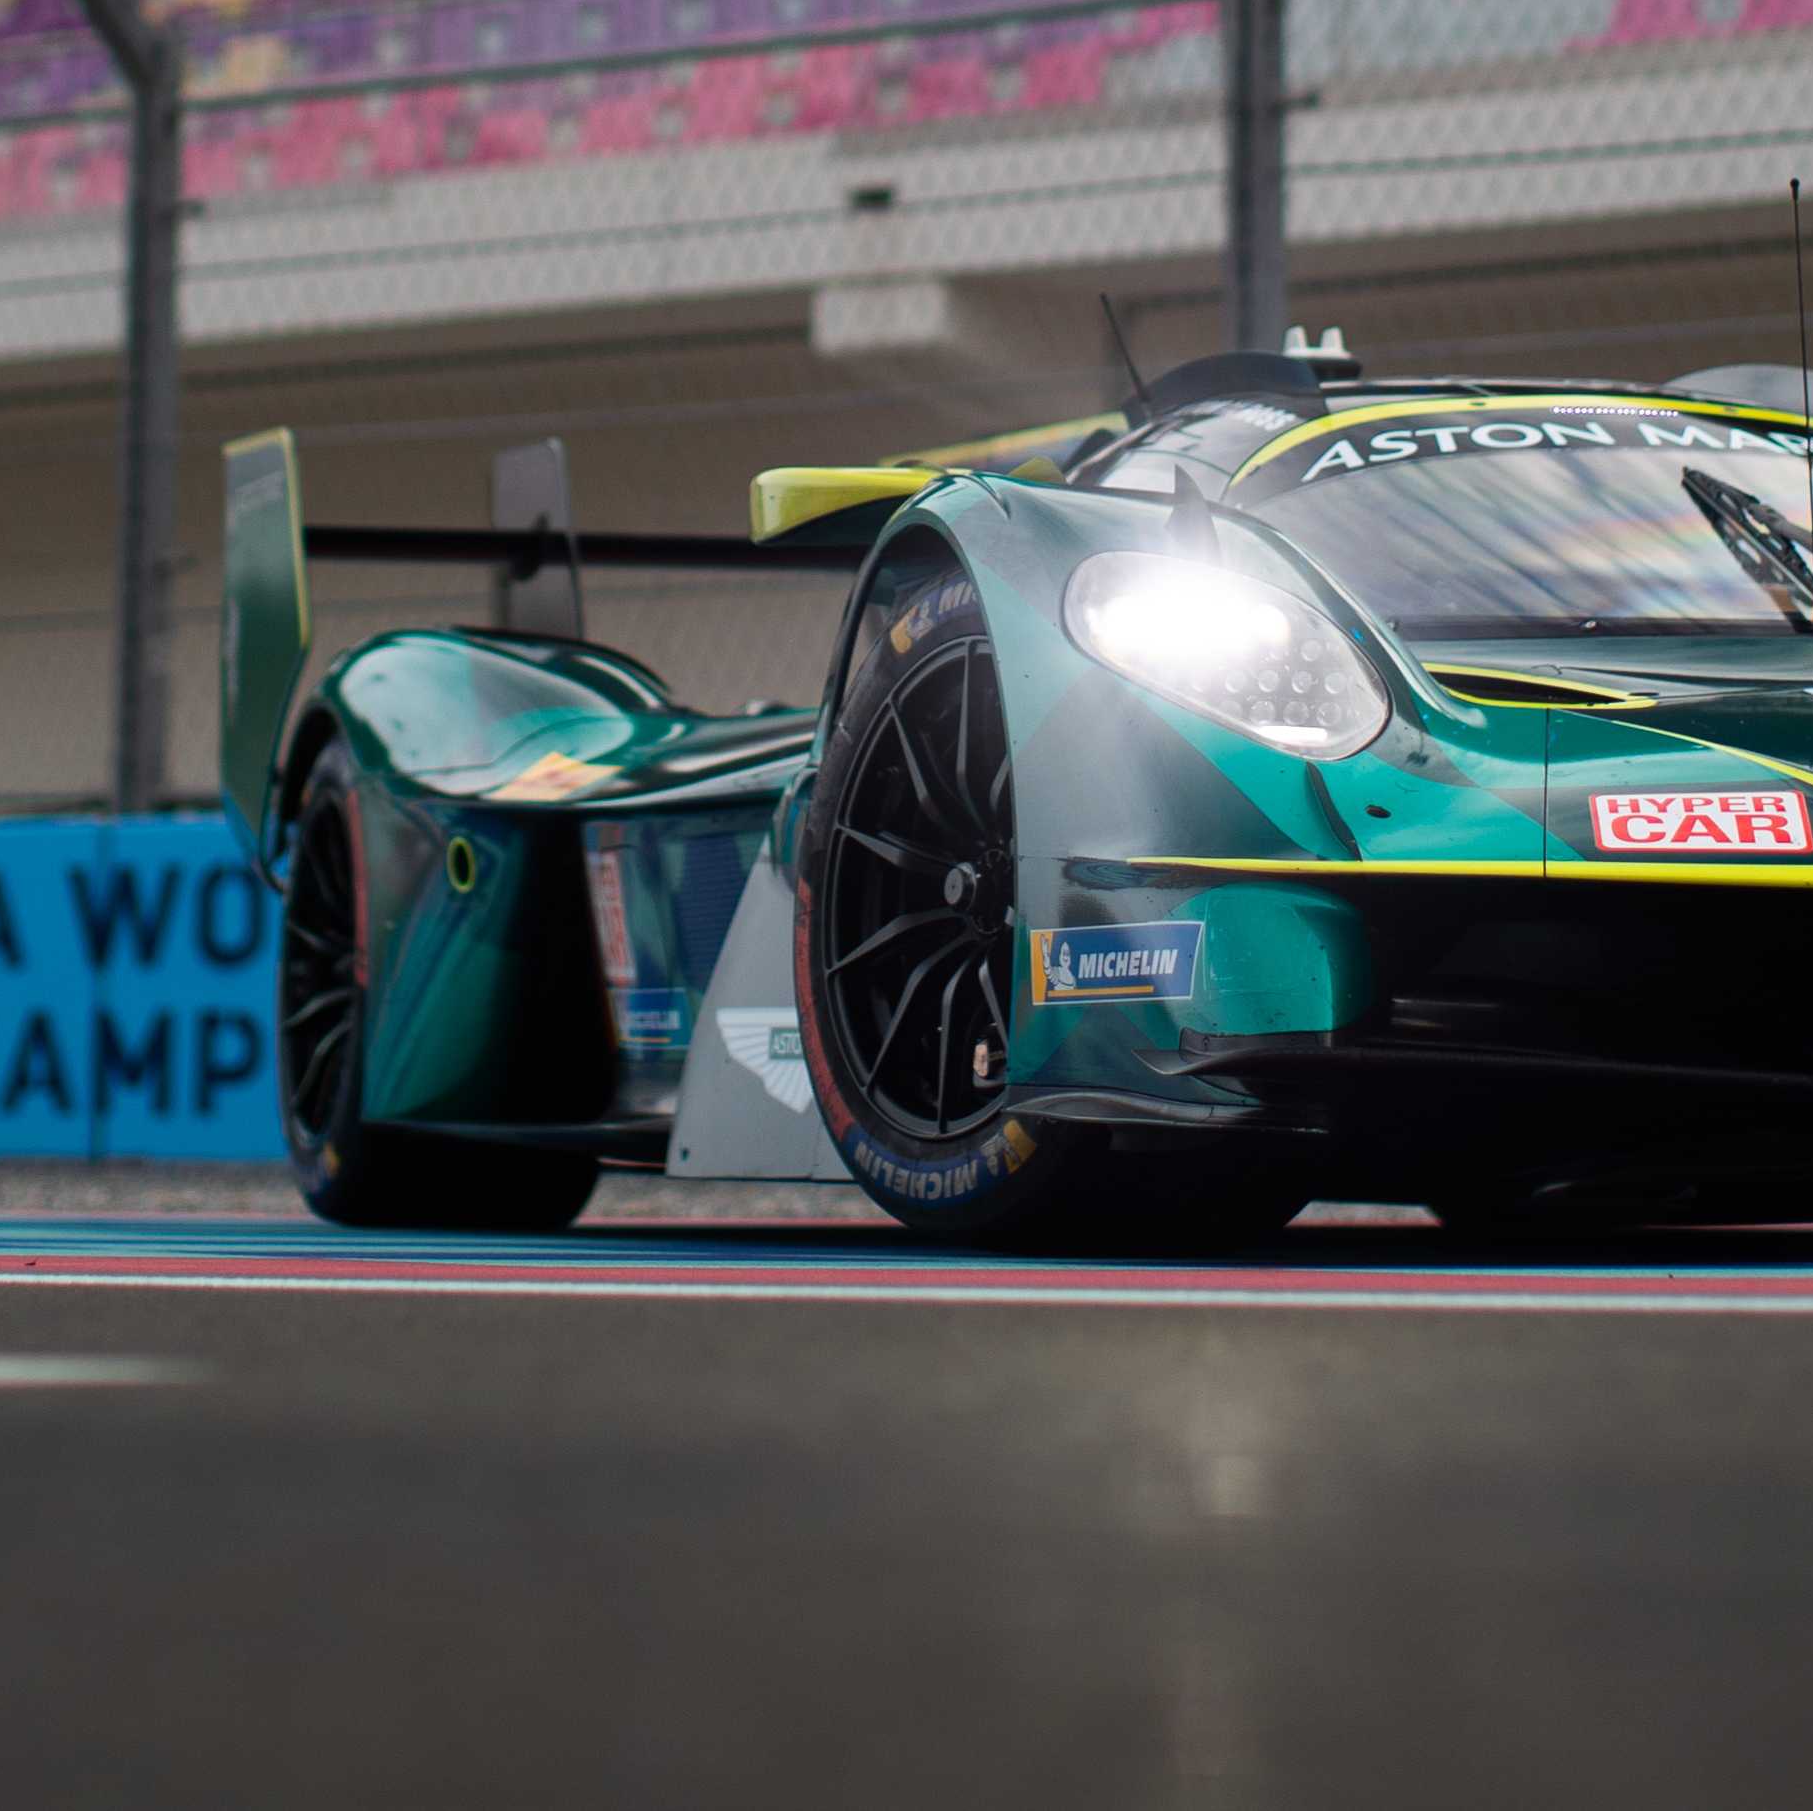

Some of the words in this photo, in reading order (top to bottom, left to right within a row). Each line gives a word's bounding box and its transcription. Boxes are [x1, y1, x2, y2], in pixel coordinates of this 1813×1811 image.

[1301, 422, 1615, 482] ASTON
[1607, 796, 1787, 814] HYPER
[1611, 814, 1794, 845] CAR
[70, 867, 264, 970] WO
[1078, 949, 1178, 979] MICHELIN
[773, 1033, 803, 1055] ASTO
[854, 1141, 979, 1200] MICHELIN
